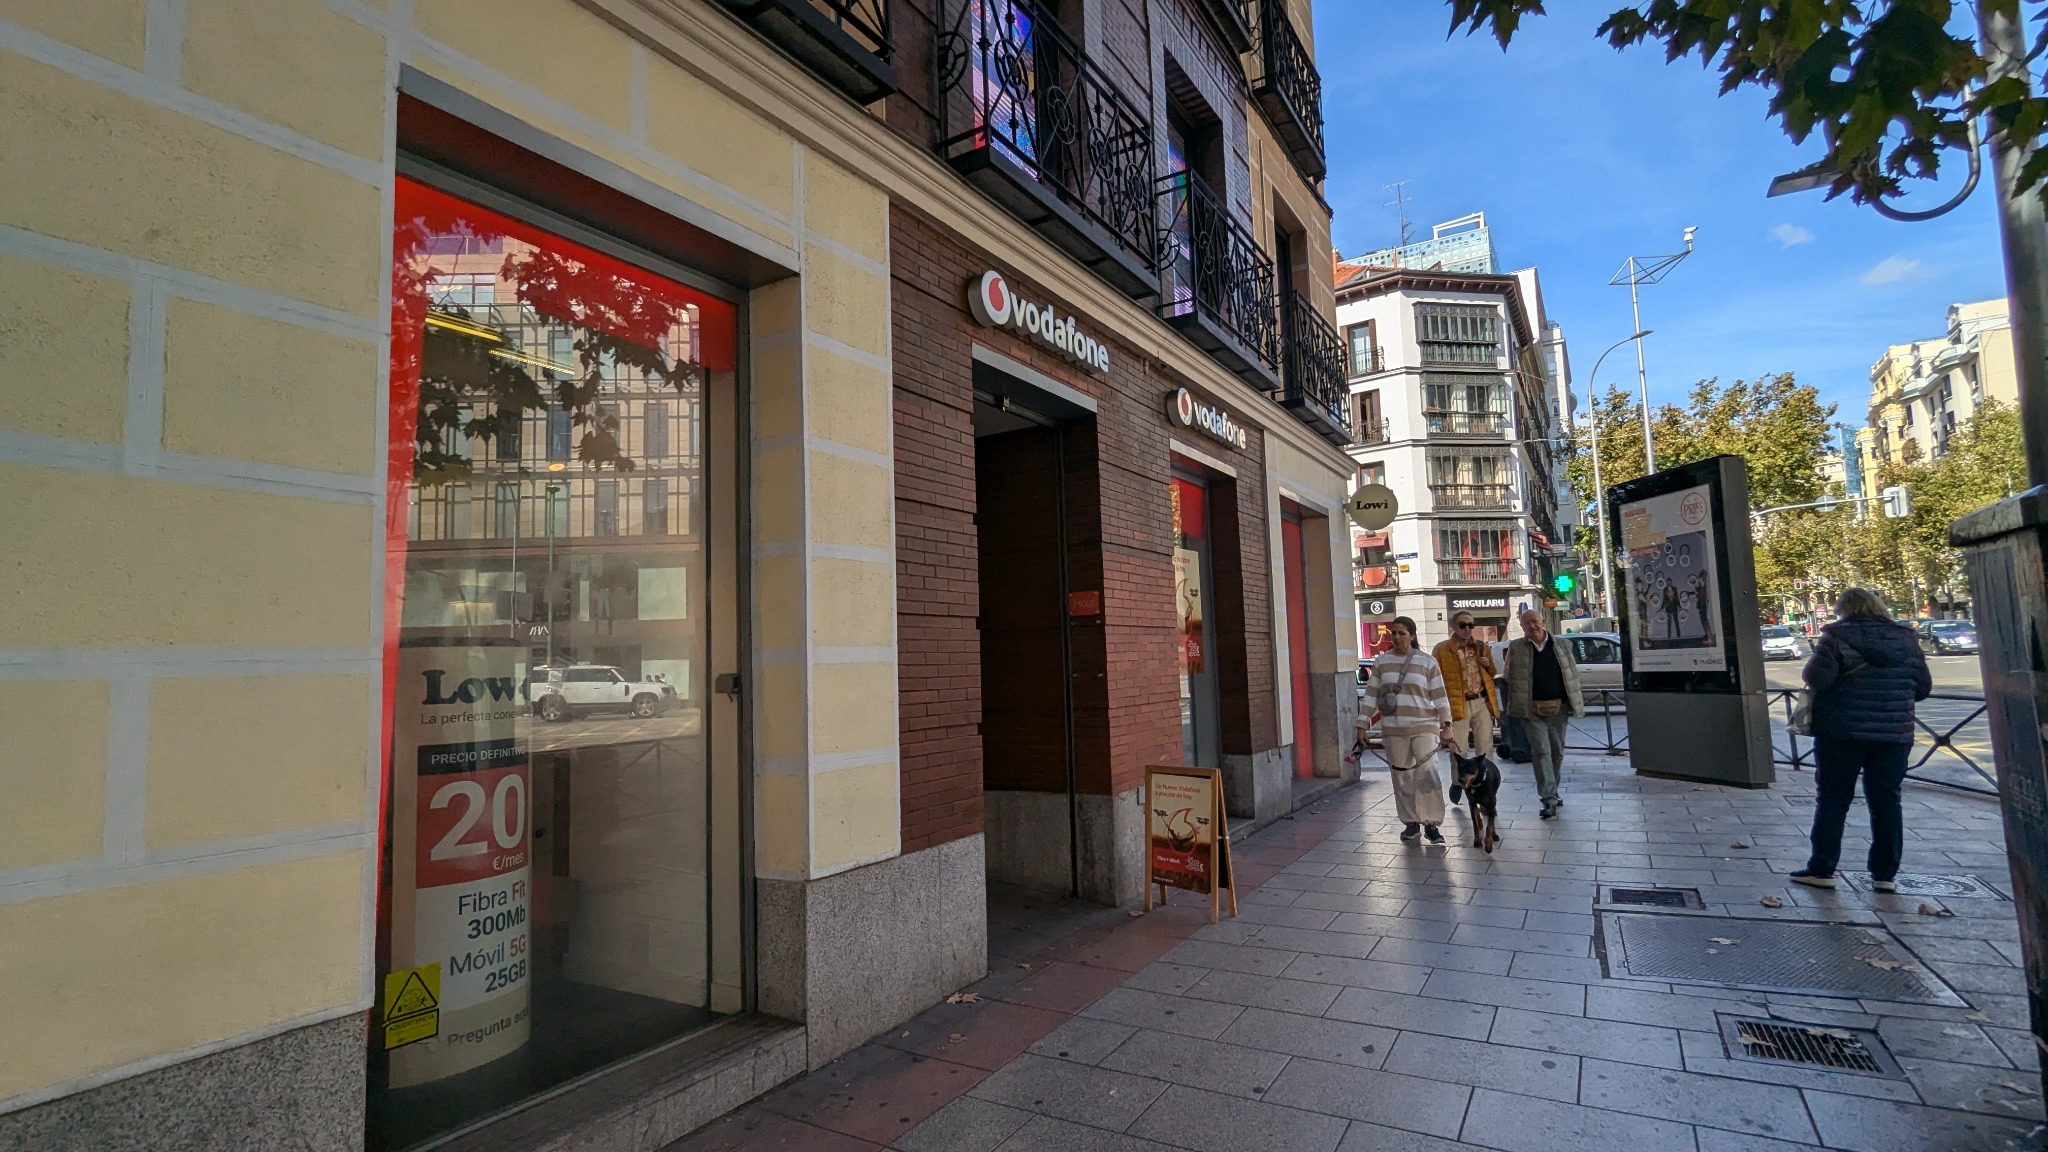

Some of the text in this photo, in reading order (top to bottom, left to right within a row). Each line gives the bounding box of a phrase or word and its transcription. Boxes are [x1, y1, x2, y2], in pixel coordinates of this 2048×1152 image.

[1009, 291, 1109, 373] vodafone
[1193, 401, 1246, 450] vodafone
[1355, 499, 1389, 510] Lowi
[1453, 599, 1505, 608] SINGULARU
[422, 669, 517, 705] Low
[420, 713, 437, 725] La
[441, 711, 491, 726] perfecta
[431, 751, 477, 765] PRECIO
[430, 773, 525, 862] 20
[492, 852, 524, 871] €/mes
[458, 880, 526, 915] Fibra Fit
[467, 904, 526, 940] 300Mb
[450, 934, 526, 976] Móvil 5G
[485, 959, 526, 993] 25GB
[448, 1016, 511, 1045] Pregunta
